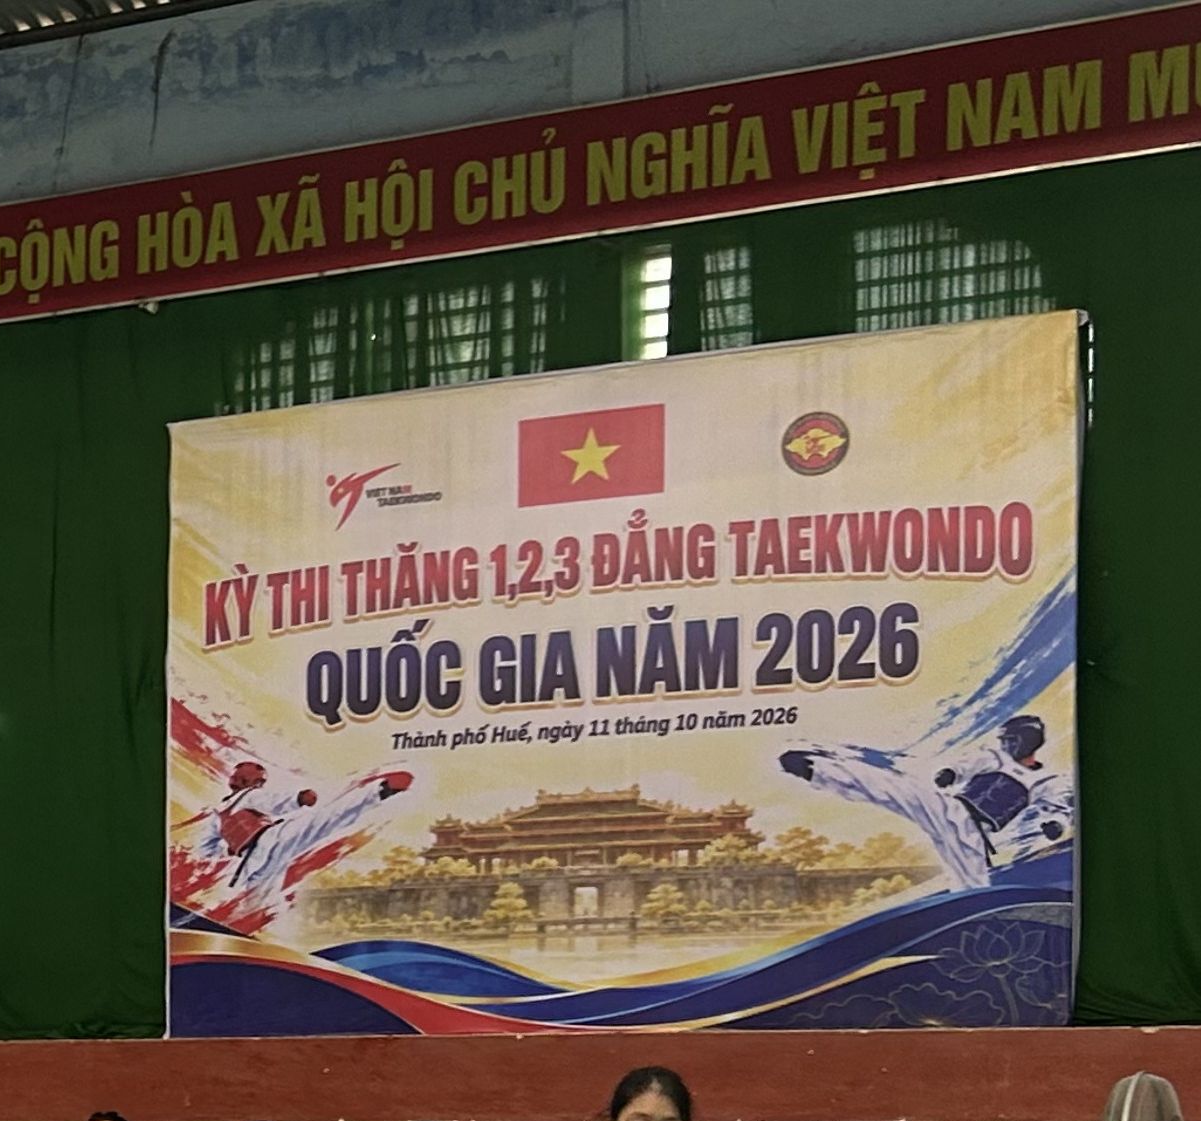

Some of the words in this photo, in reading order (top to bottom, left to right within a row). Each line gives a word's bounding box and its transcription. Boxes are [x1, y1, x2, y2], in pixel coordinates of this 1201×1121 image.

[136, 192, 239, 274] HÒA
[255, 175, 326, 257] XÃ
[344, 159, 434, 250] HỘI
[454, 127, 565, 225] CHỦ
[587, 103, 771, 206] NGHĨA
[792, 82, 926, 180] VIỆT
[946, 59, 1102, 152] NAM
[1128, 43, 1201, 123] M
[205, 563, 258, 646] KỲ
[267, 565, 330, 631] THI
[341, 541, 479, 616] THĂNG
[489, 536, 580, 601] 1,2,3
[591, 508, 716, 587] ĐẲNG
[729, 501, 1033, 577] TAEKWONDO
[307, 619, 462, 726] QUỐC
[479, 630, 580, 705] GIA
[596, 605, 739, 697] NĂM
[755, 602, 920, 687] 2026
[392, 730, 446, 749] Thành
[450, 723, 490, 750] phố
[491, 721, 532, 744] Huế,
[538, 720, 584, 743] ngày
[588, 718, 610, 736] 11
[615, 716, 670, 736] tháng
[674, 713, 698, 731] 10
[702, 711, 745, 729] năm
[751, 706, 798, 726] 2026
